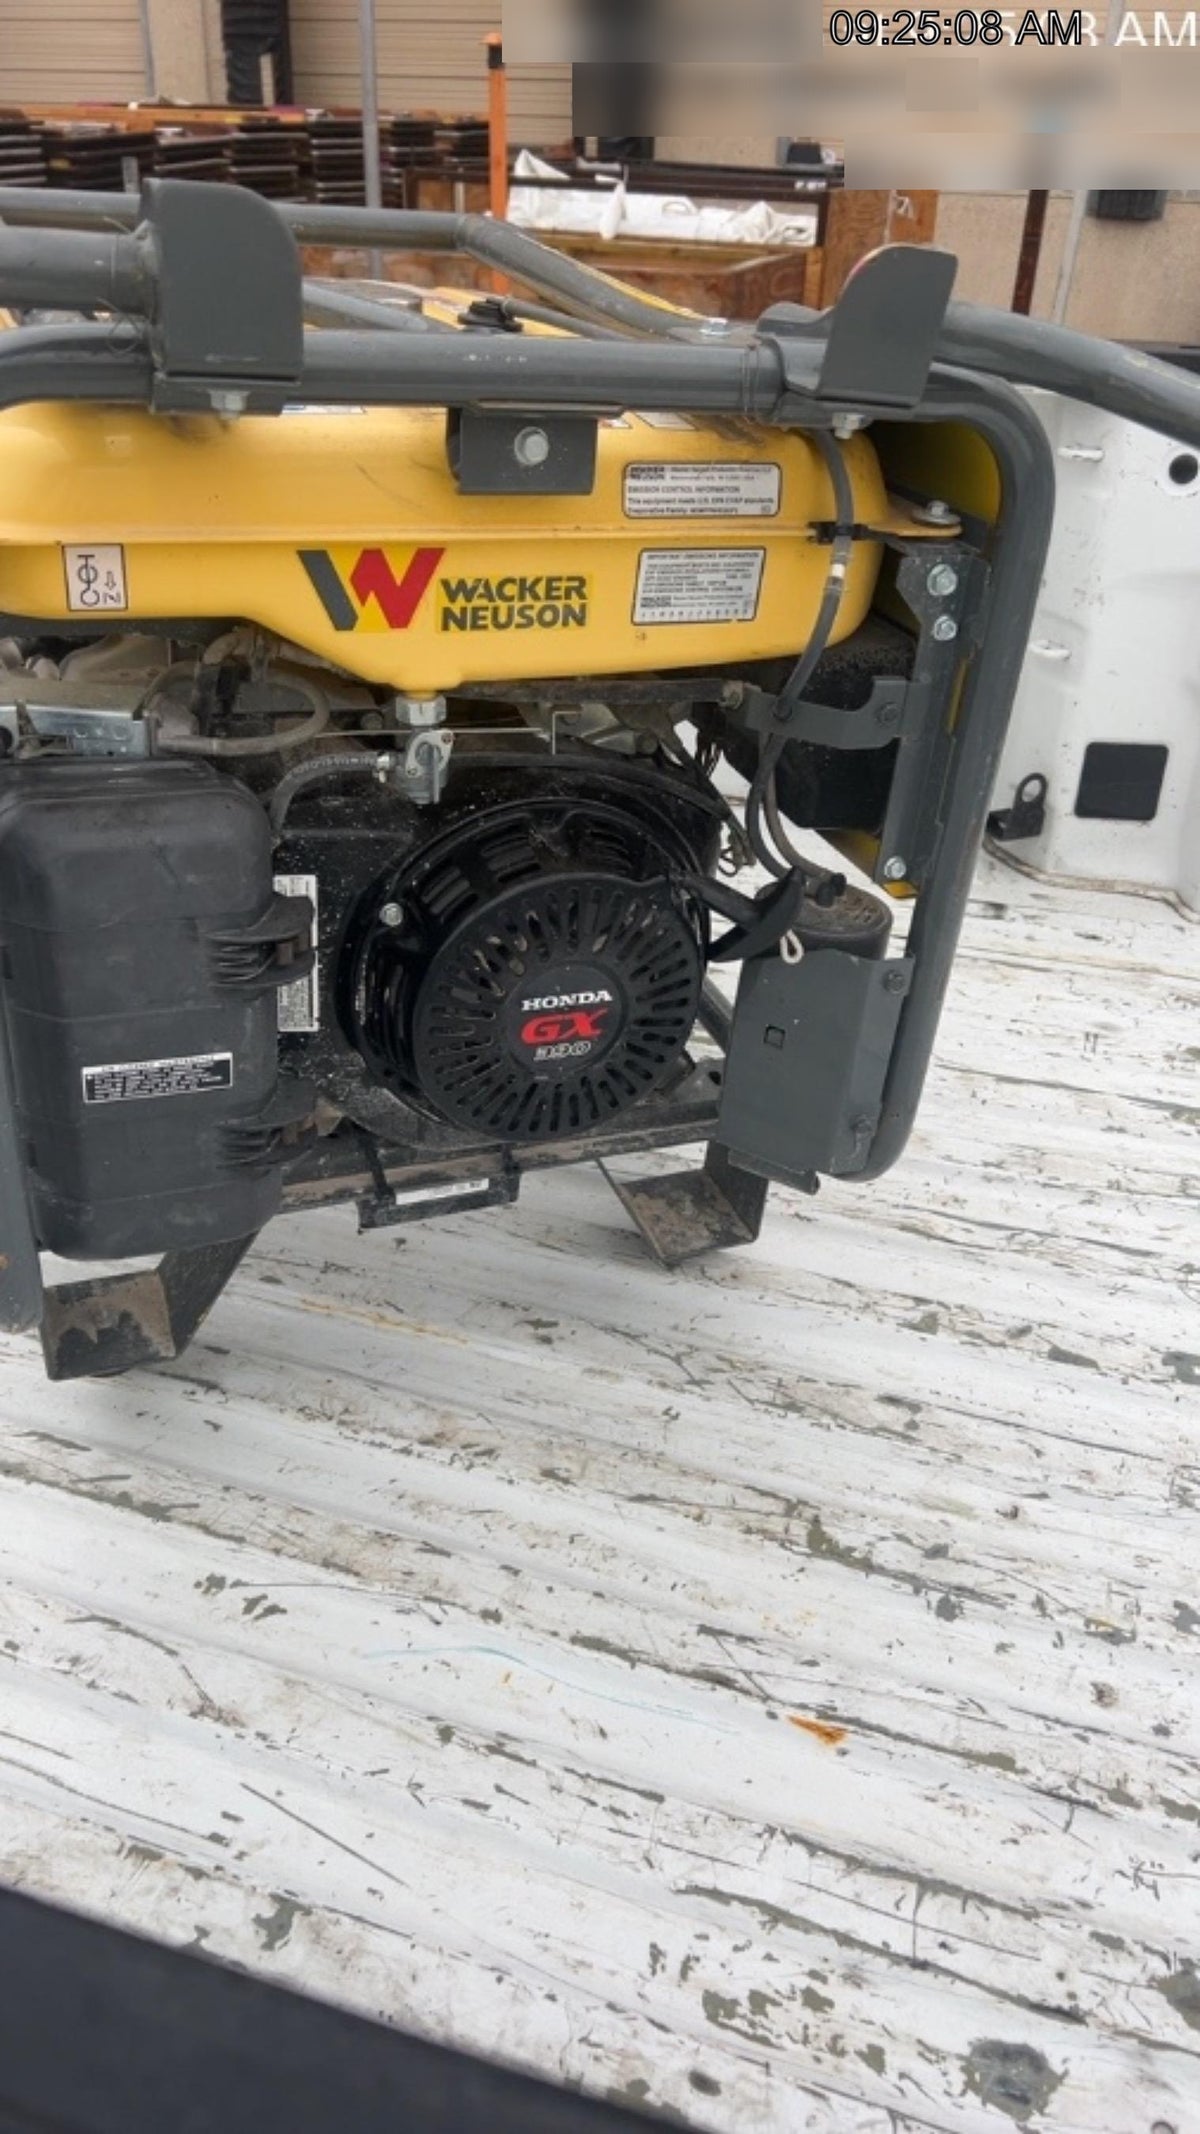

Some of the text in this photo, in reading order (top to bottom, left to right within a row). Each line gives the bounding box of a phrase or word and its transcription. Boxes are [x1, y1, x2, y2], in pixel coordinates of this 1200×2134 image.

[440, 575, 588, 603] WACKER
[441, 604, 587, 632] NEUSON
[521, 989, 613, 1012] HONDA
[521, 1007, 608, 1045] GX
